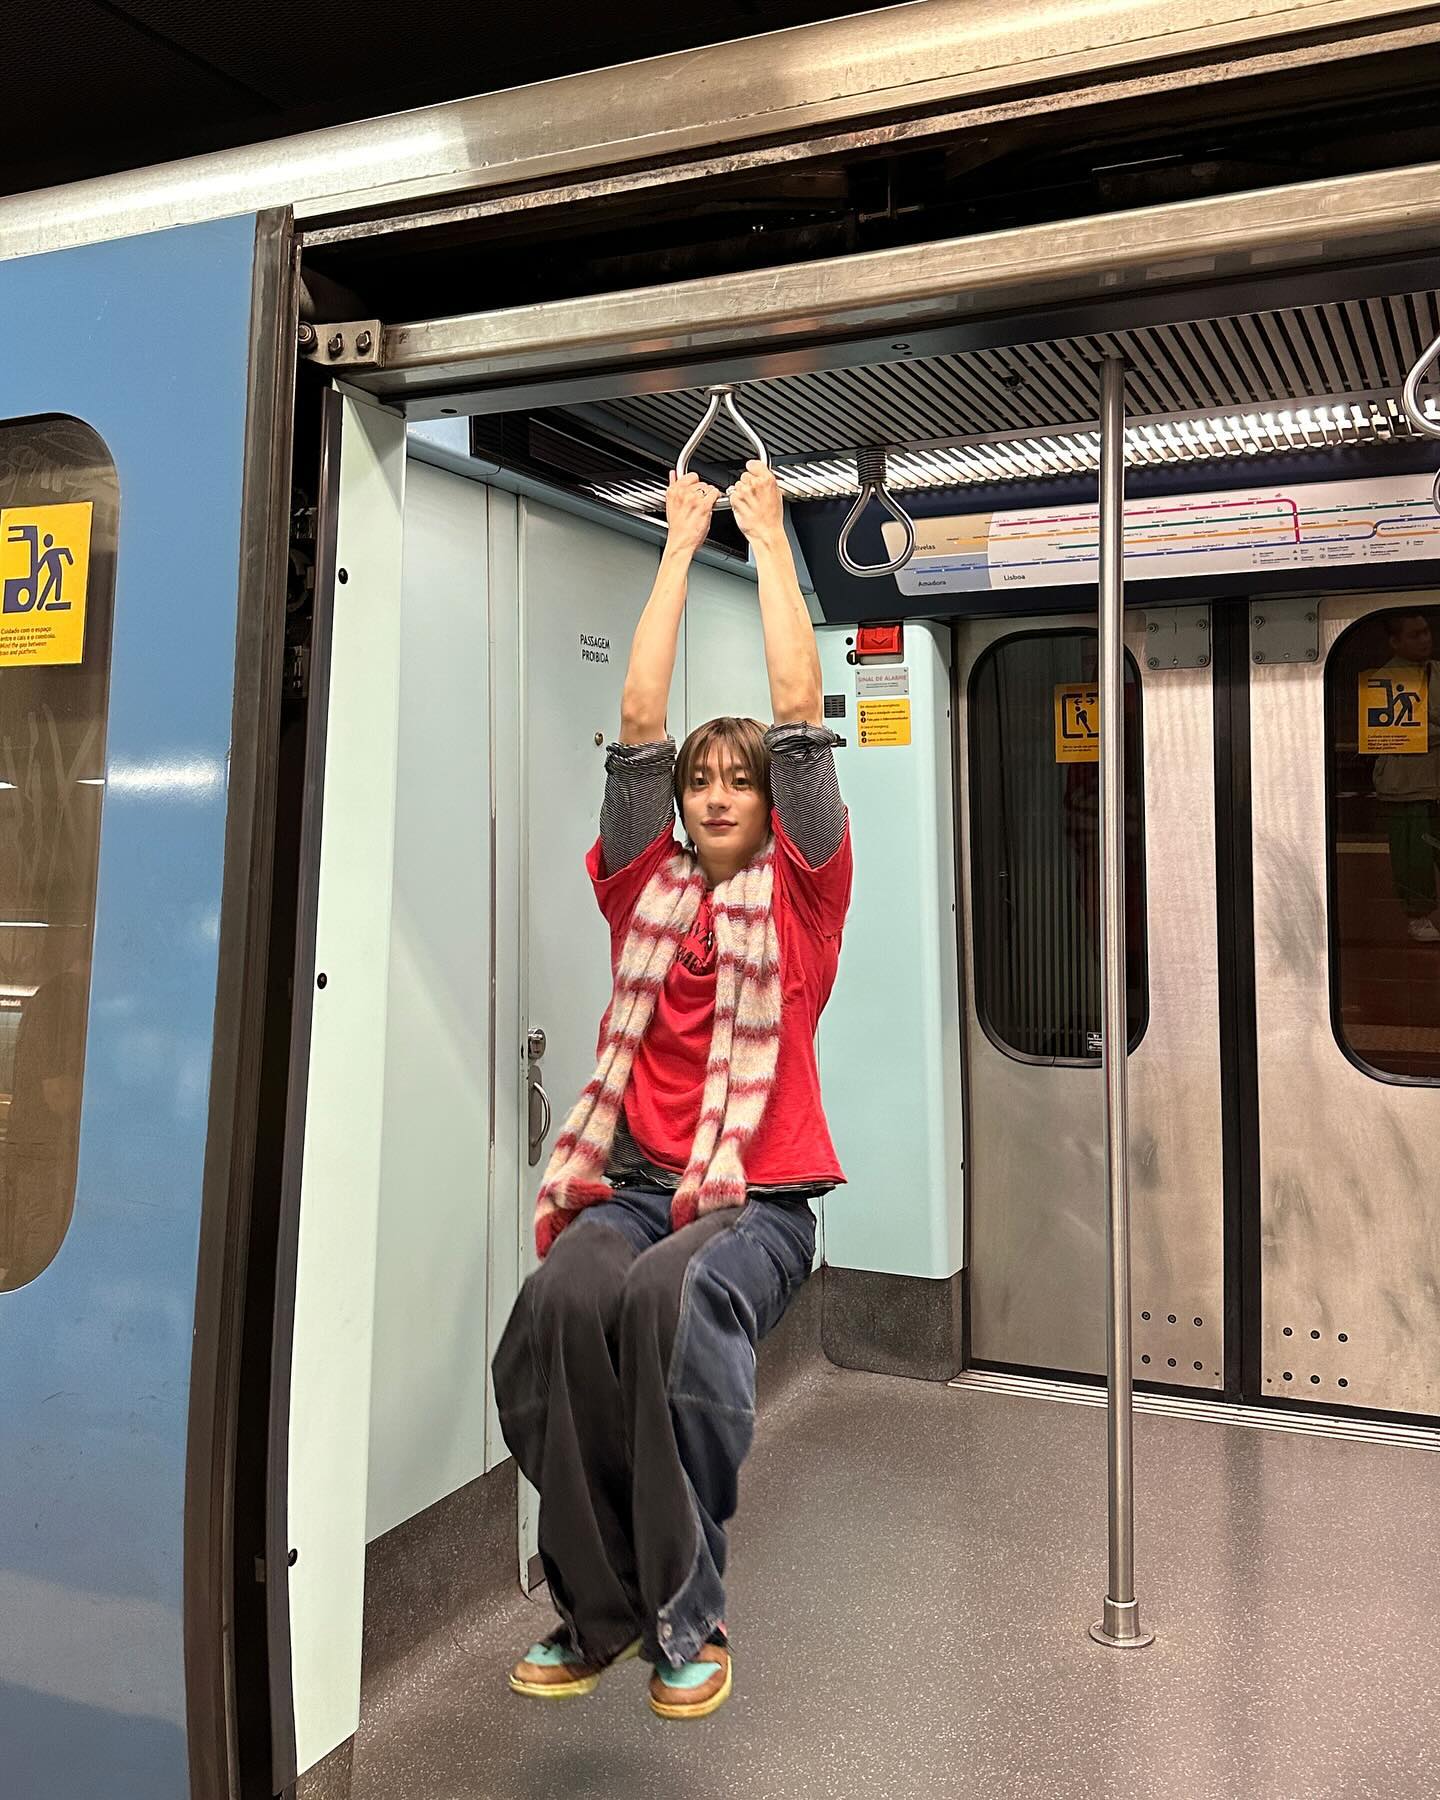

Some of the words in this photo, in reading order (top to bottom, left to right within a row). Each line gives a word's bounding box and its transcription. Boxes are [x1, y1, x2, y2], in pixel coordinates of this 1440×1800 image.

[580, 634, 610, 649] PASSAGEM
[582, 649, 609, 664] PROIBIDA
[850, 651, 855, 663] 1
